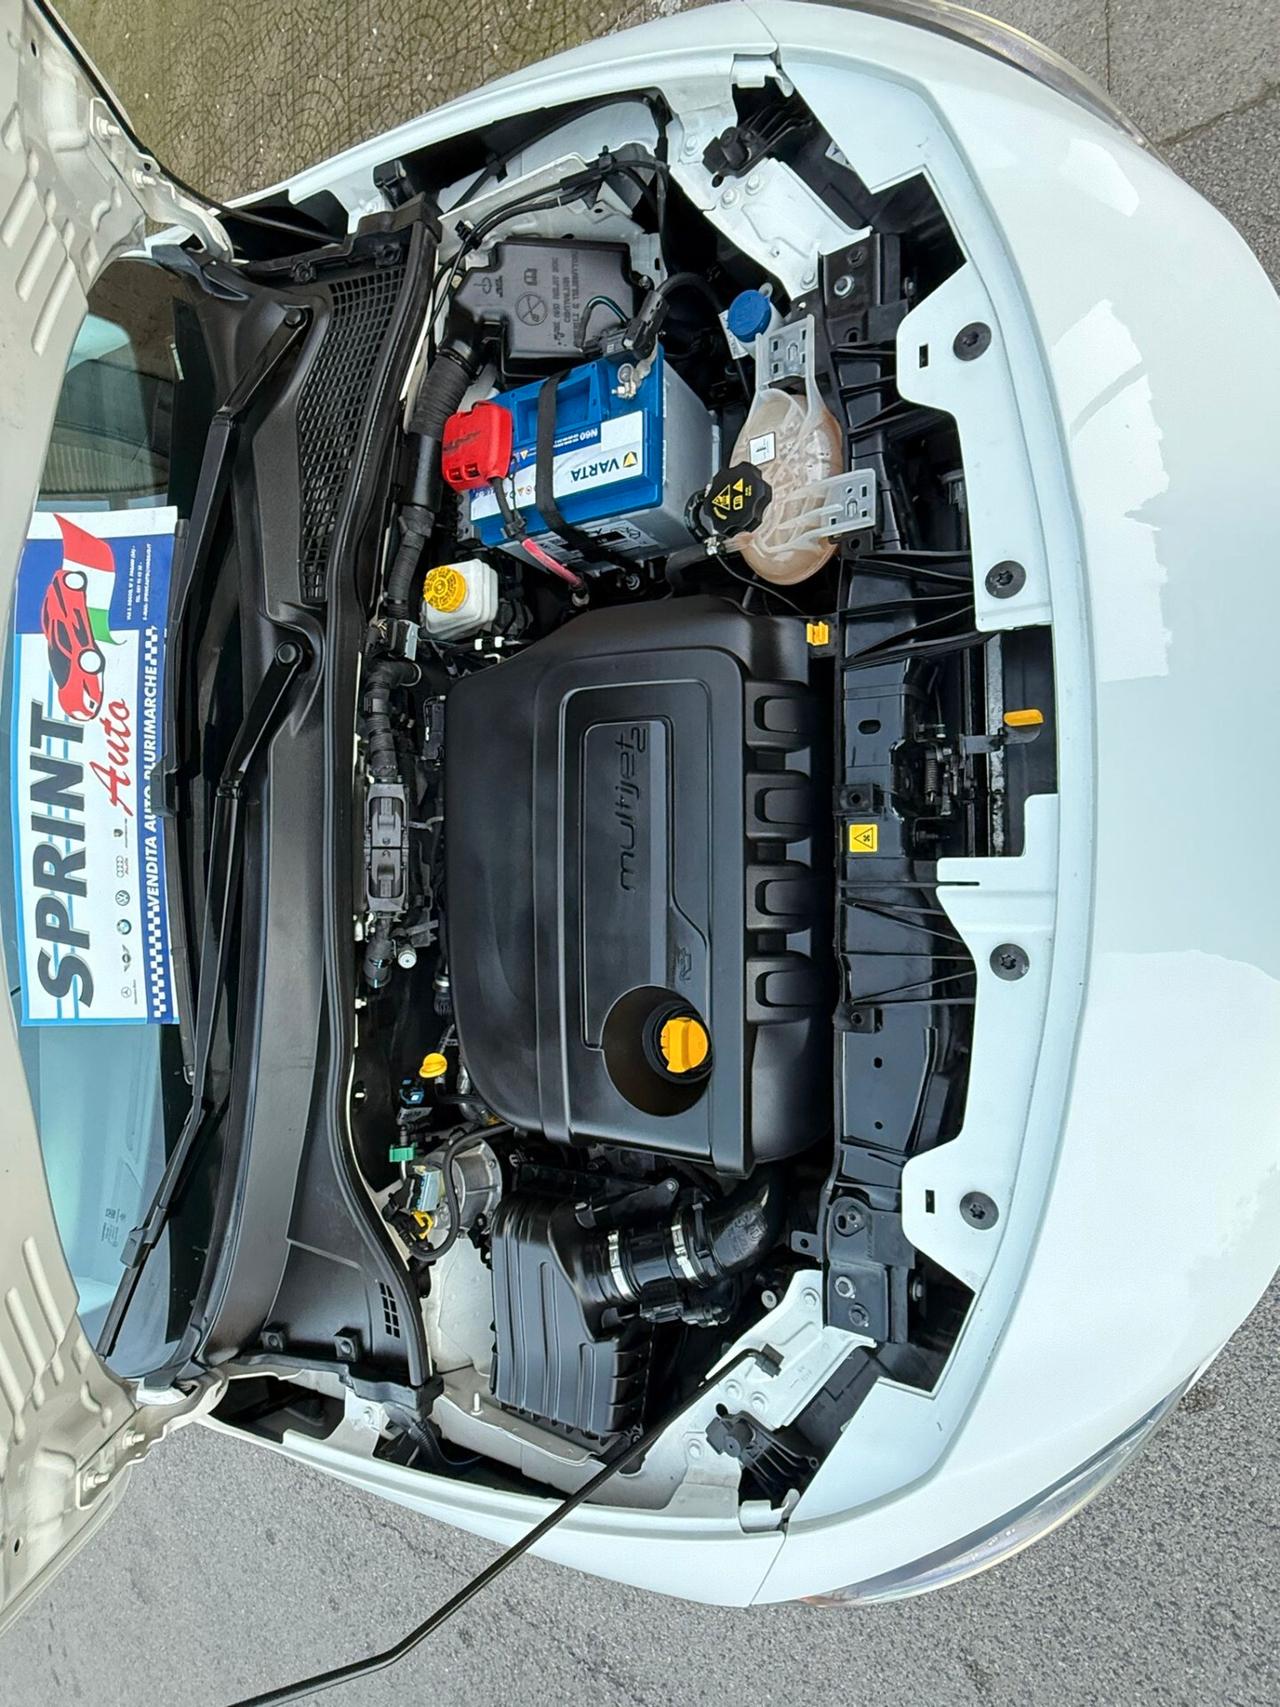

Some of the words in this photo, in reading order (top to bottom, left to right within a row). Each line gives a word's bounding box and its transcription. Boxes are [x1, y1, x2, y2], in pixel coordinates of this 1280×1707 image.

[571, 457, 620, 482] VARTA
[579, 428, 598, 440] N60
[89, 698, 133, 816] Auto
[30, 699, 94, 1007] SPRINT
[145, 836, 160, 909] VENDITA
